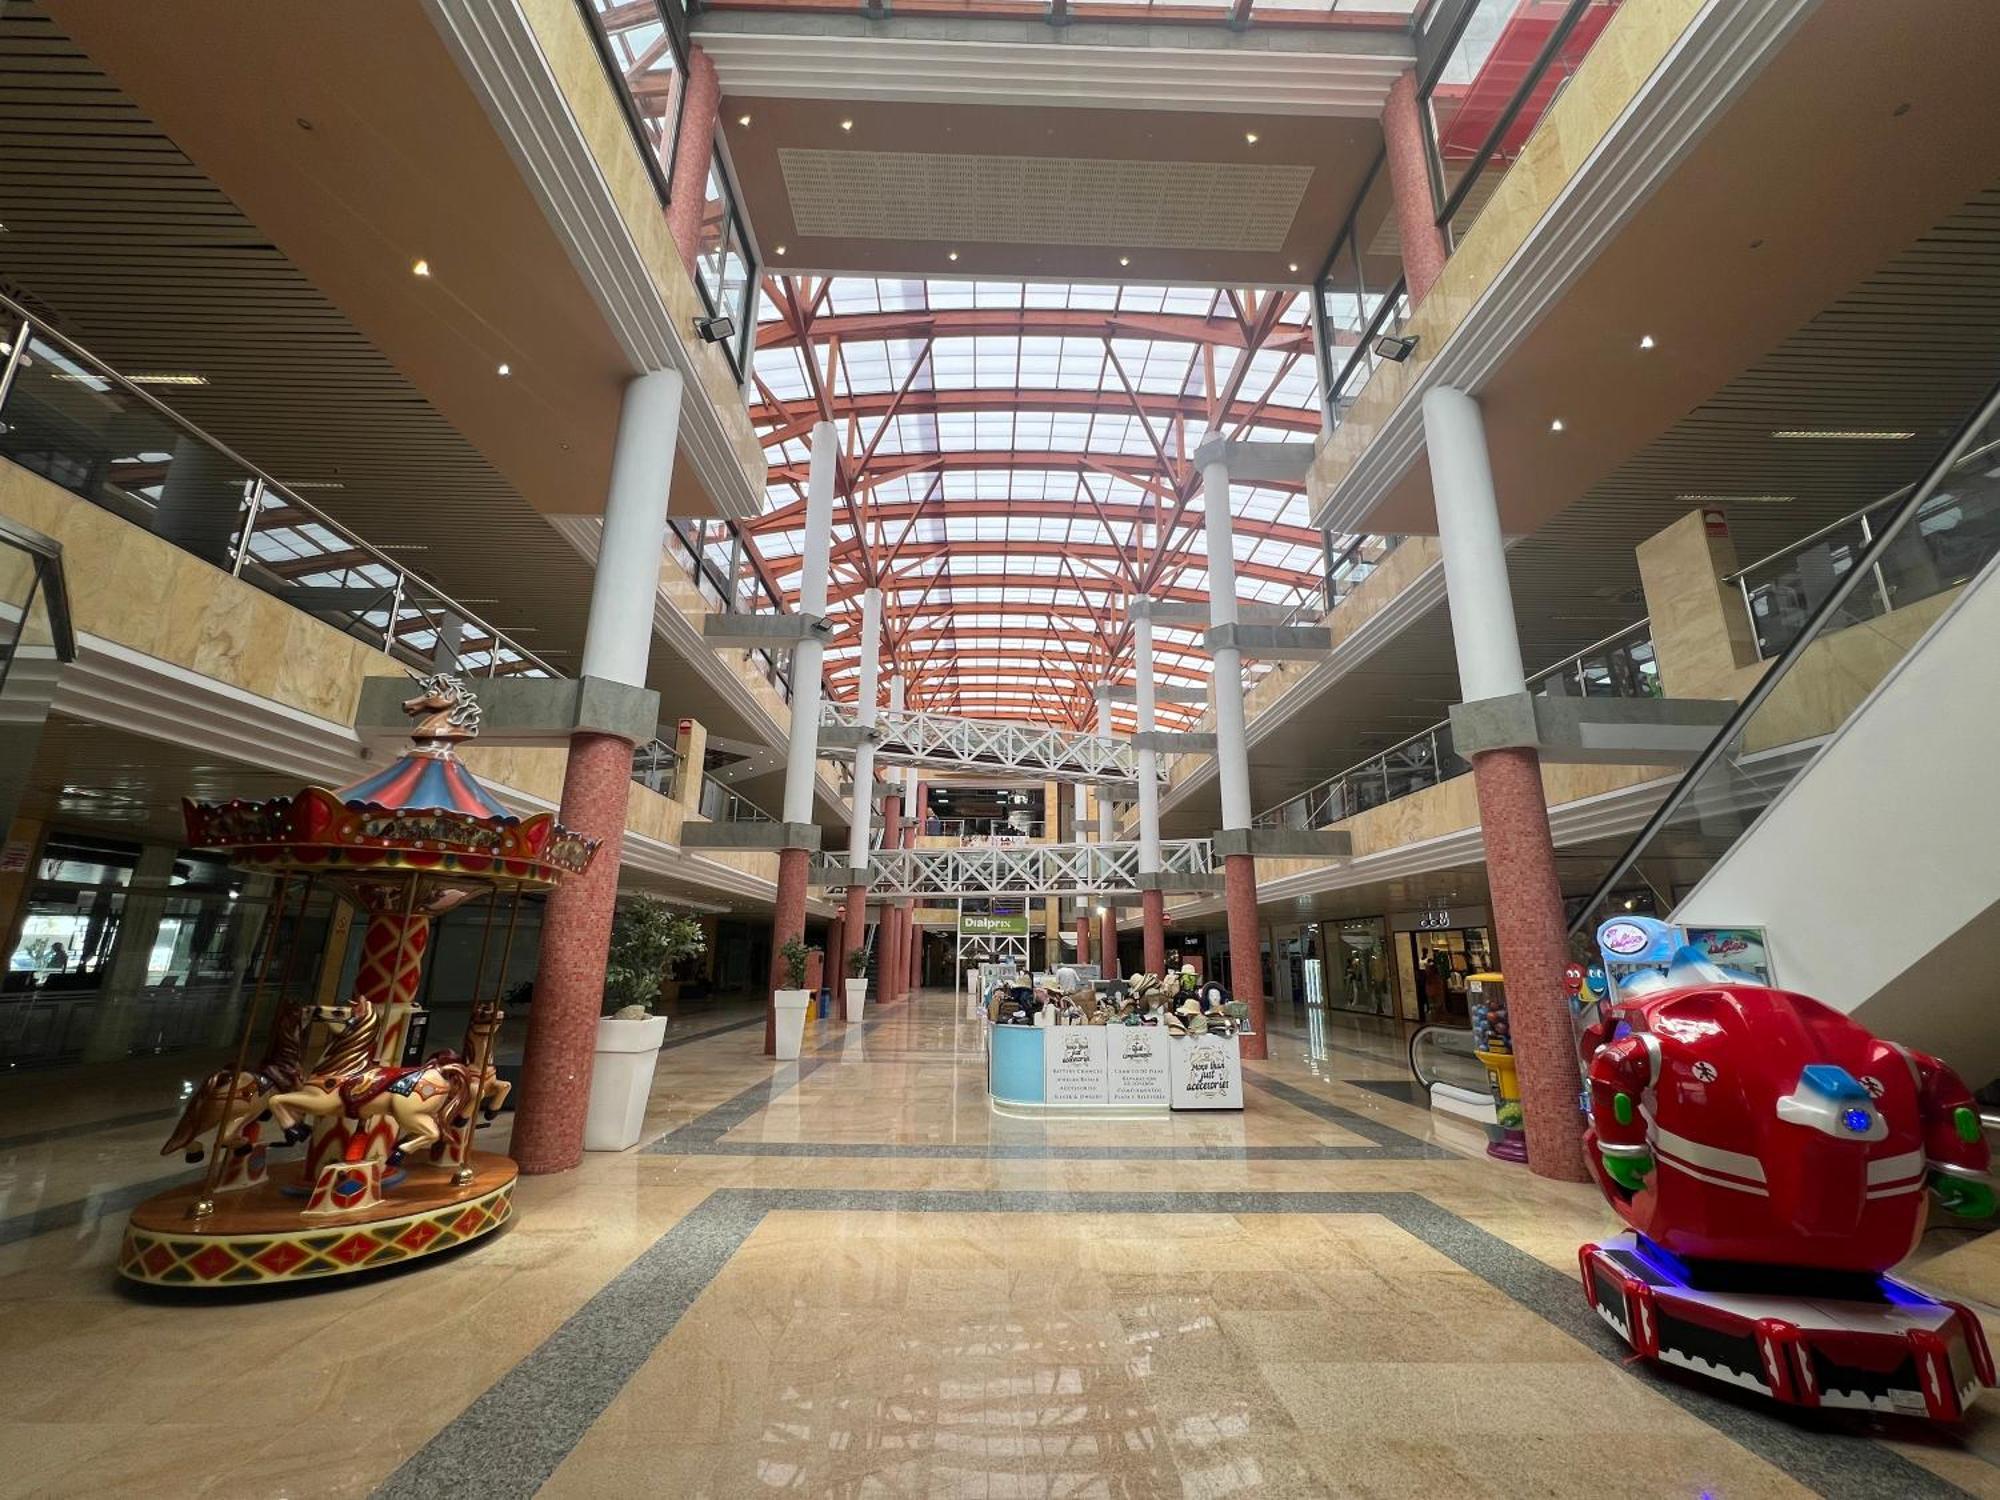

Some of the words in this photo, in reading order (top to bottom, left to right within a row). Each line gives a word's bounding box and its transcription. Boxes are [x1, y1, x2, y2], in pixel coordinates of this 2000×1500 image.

[964, 917, 1011, 930] Dialprix
[1191, 1063, 1208, 1071] More
[1210, 1060, 1225, 1070] than
